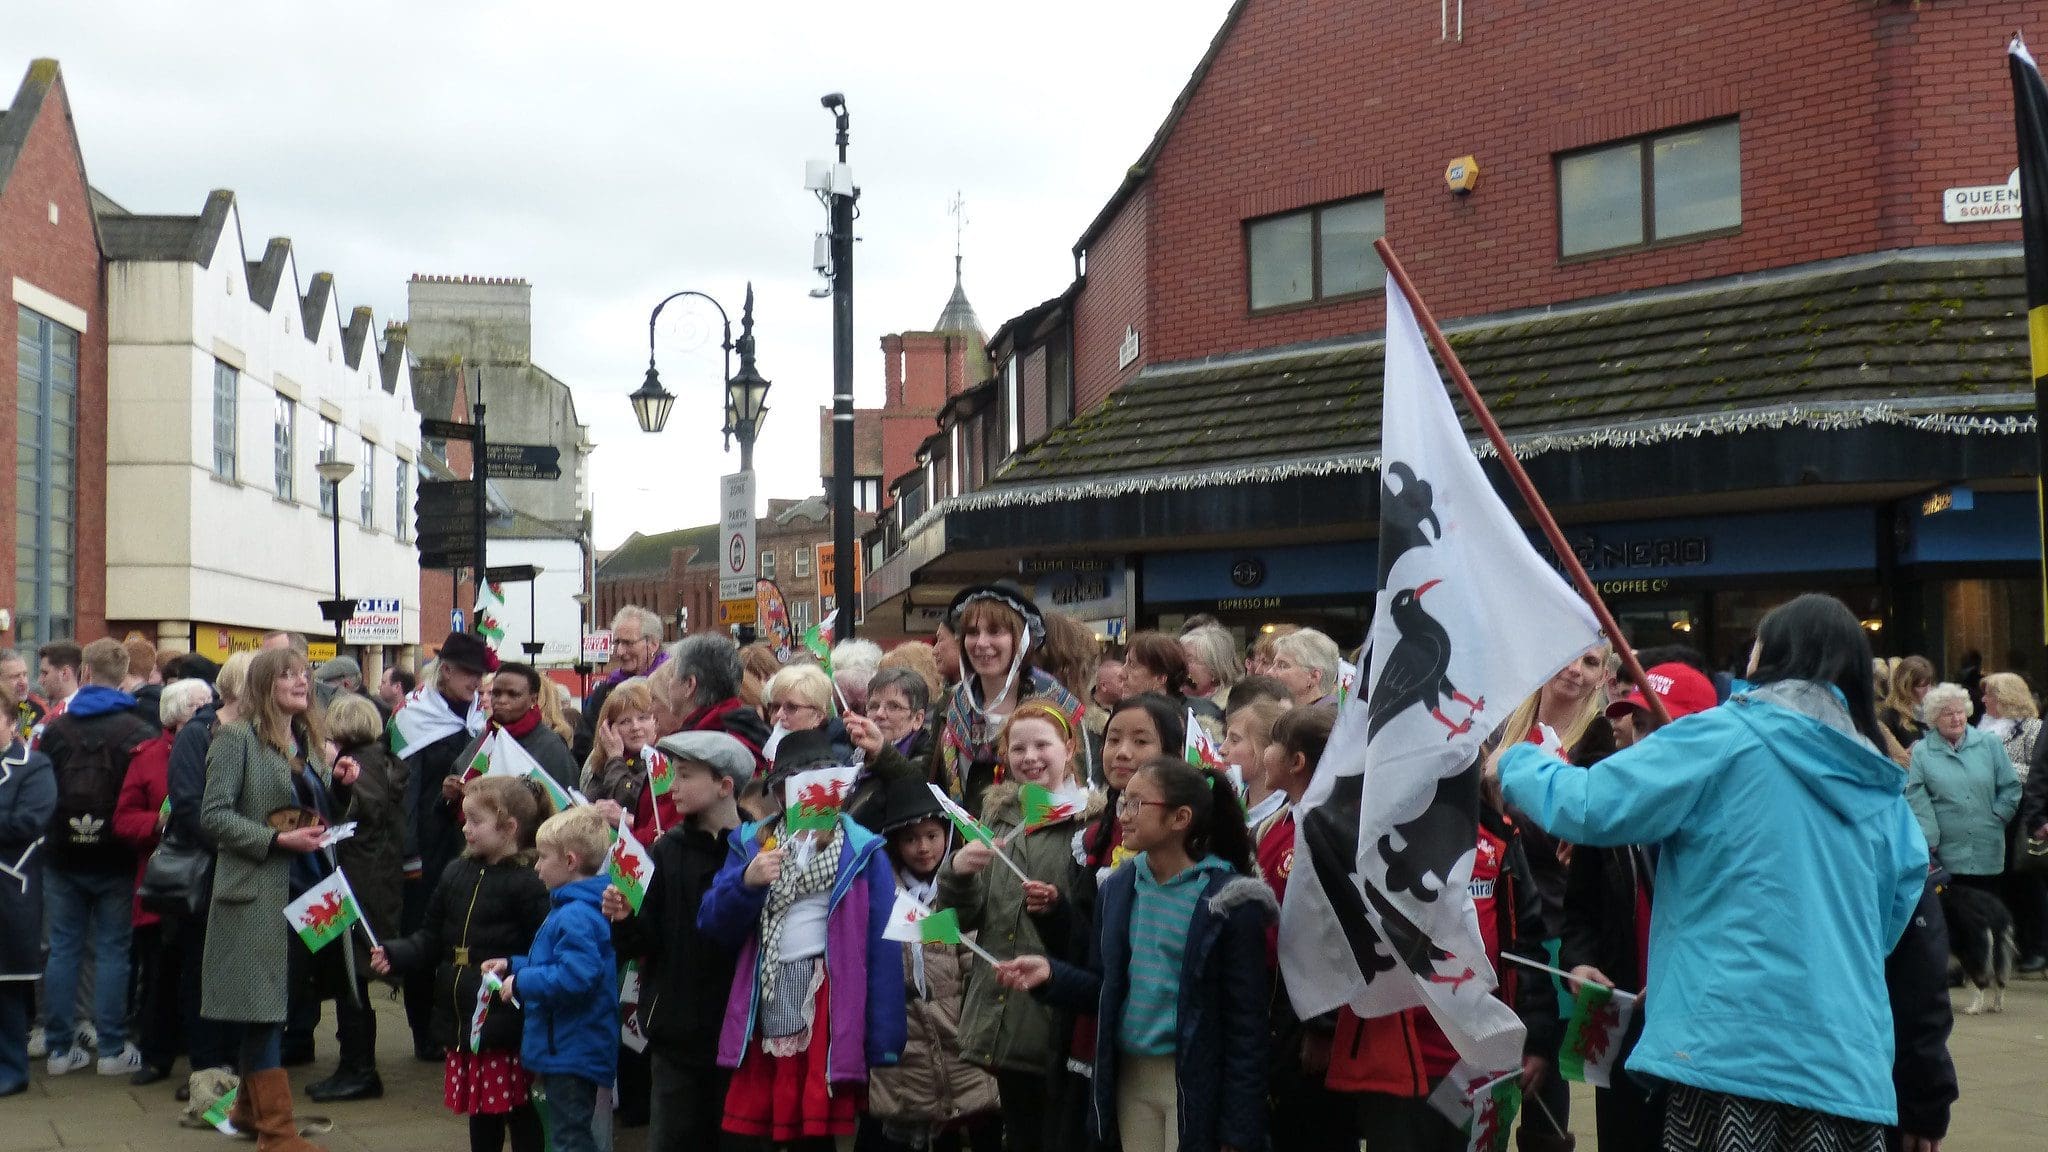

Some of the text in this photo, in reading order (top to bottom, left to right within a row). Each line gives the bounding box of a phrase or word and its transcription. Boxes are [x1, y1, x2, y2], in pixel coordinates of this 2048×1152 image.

[821, 553, 835, 565] SHO
[1602, 540, 1706, 569] NERO
[1603, 579, 1650, 595] COFFEE
[374, 600, 396, 613] LET
[1264, 597, 1281, 609] BAR
